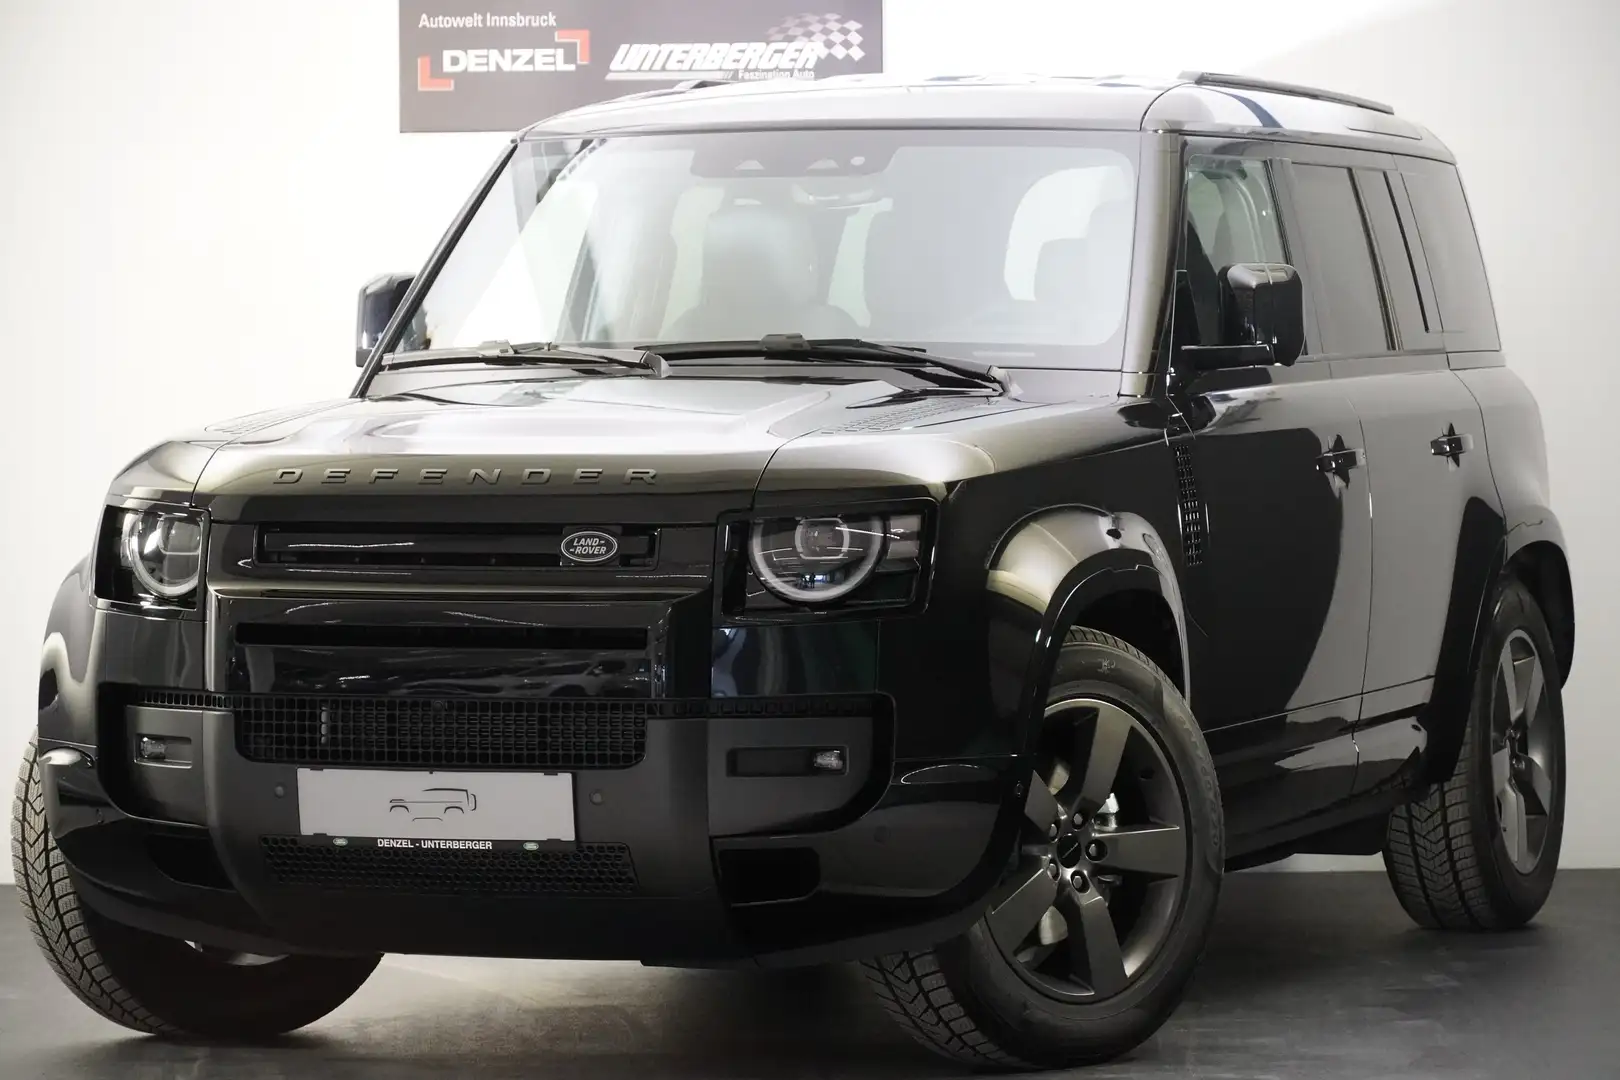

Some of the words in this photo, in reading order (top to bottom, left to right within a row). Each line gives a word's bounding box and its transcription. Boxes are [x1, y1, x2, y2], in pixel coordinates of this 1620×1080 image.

[418, 12, 483, 28] Autowelt
[486, 11, 557, 27] Innsbruck
[442, 48, 576, 73] DENZEL
[609, 41, 824, 71] UNTERBERGER
[793, 69, 815, 78] Auto
[272, 468, 658, 485] DEFENDER
[377, 838, 414, 848] DENZEL
[421, 840, 493, 850] UNTERBERGER
